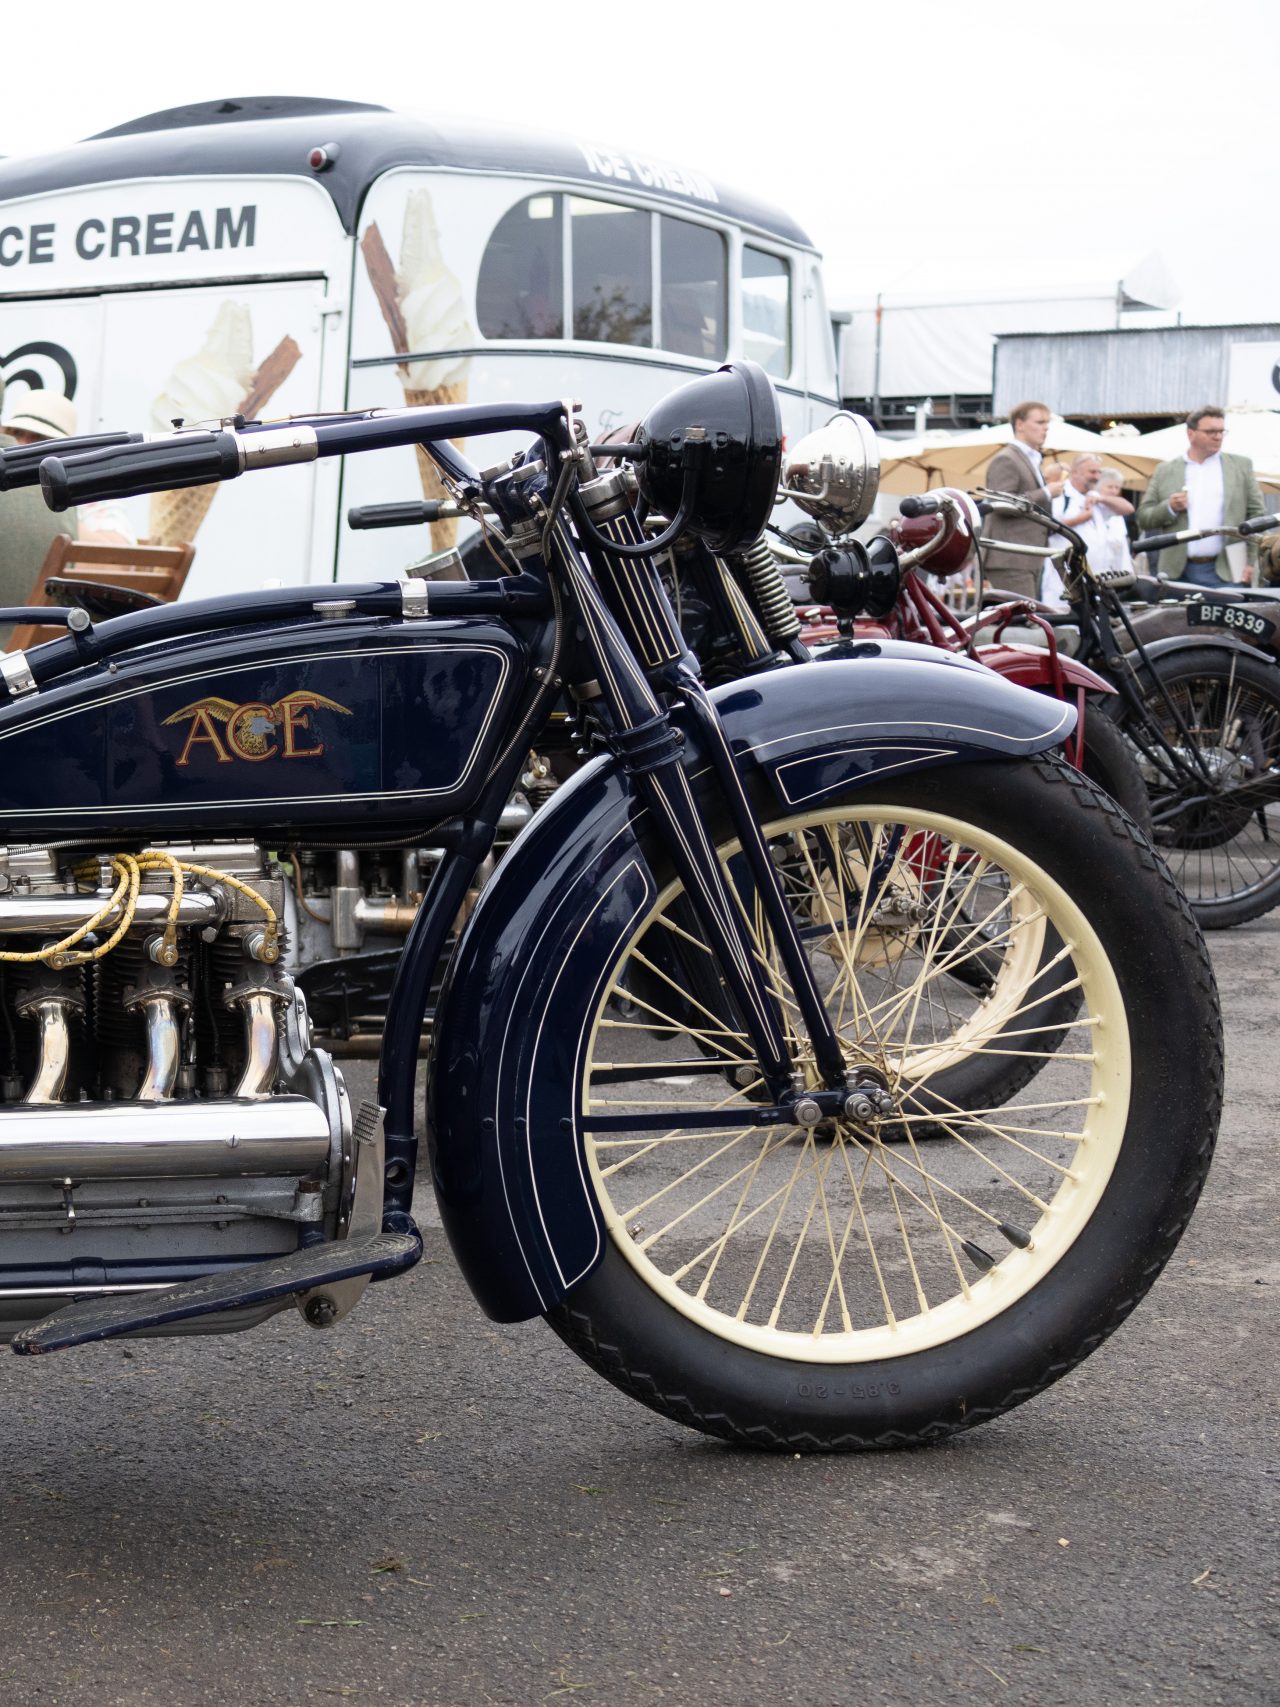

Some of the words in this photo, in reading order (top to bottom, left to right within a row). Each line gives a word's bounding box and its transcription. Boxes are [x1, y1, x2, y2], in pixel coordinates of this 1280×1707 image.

[576, 142, 632, 181] ICE
[75, 204, 257, 261] CREAM
[1200, 605, 1223, 622] BF
[1223, 607, 1265, 634] 8339
[175, 699, 325, 767] ACE
